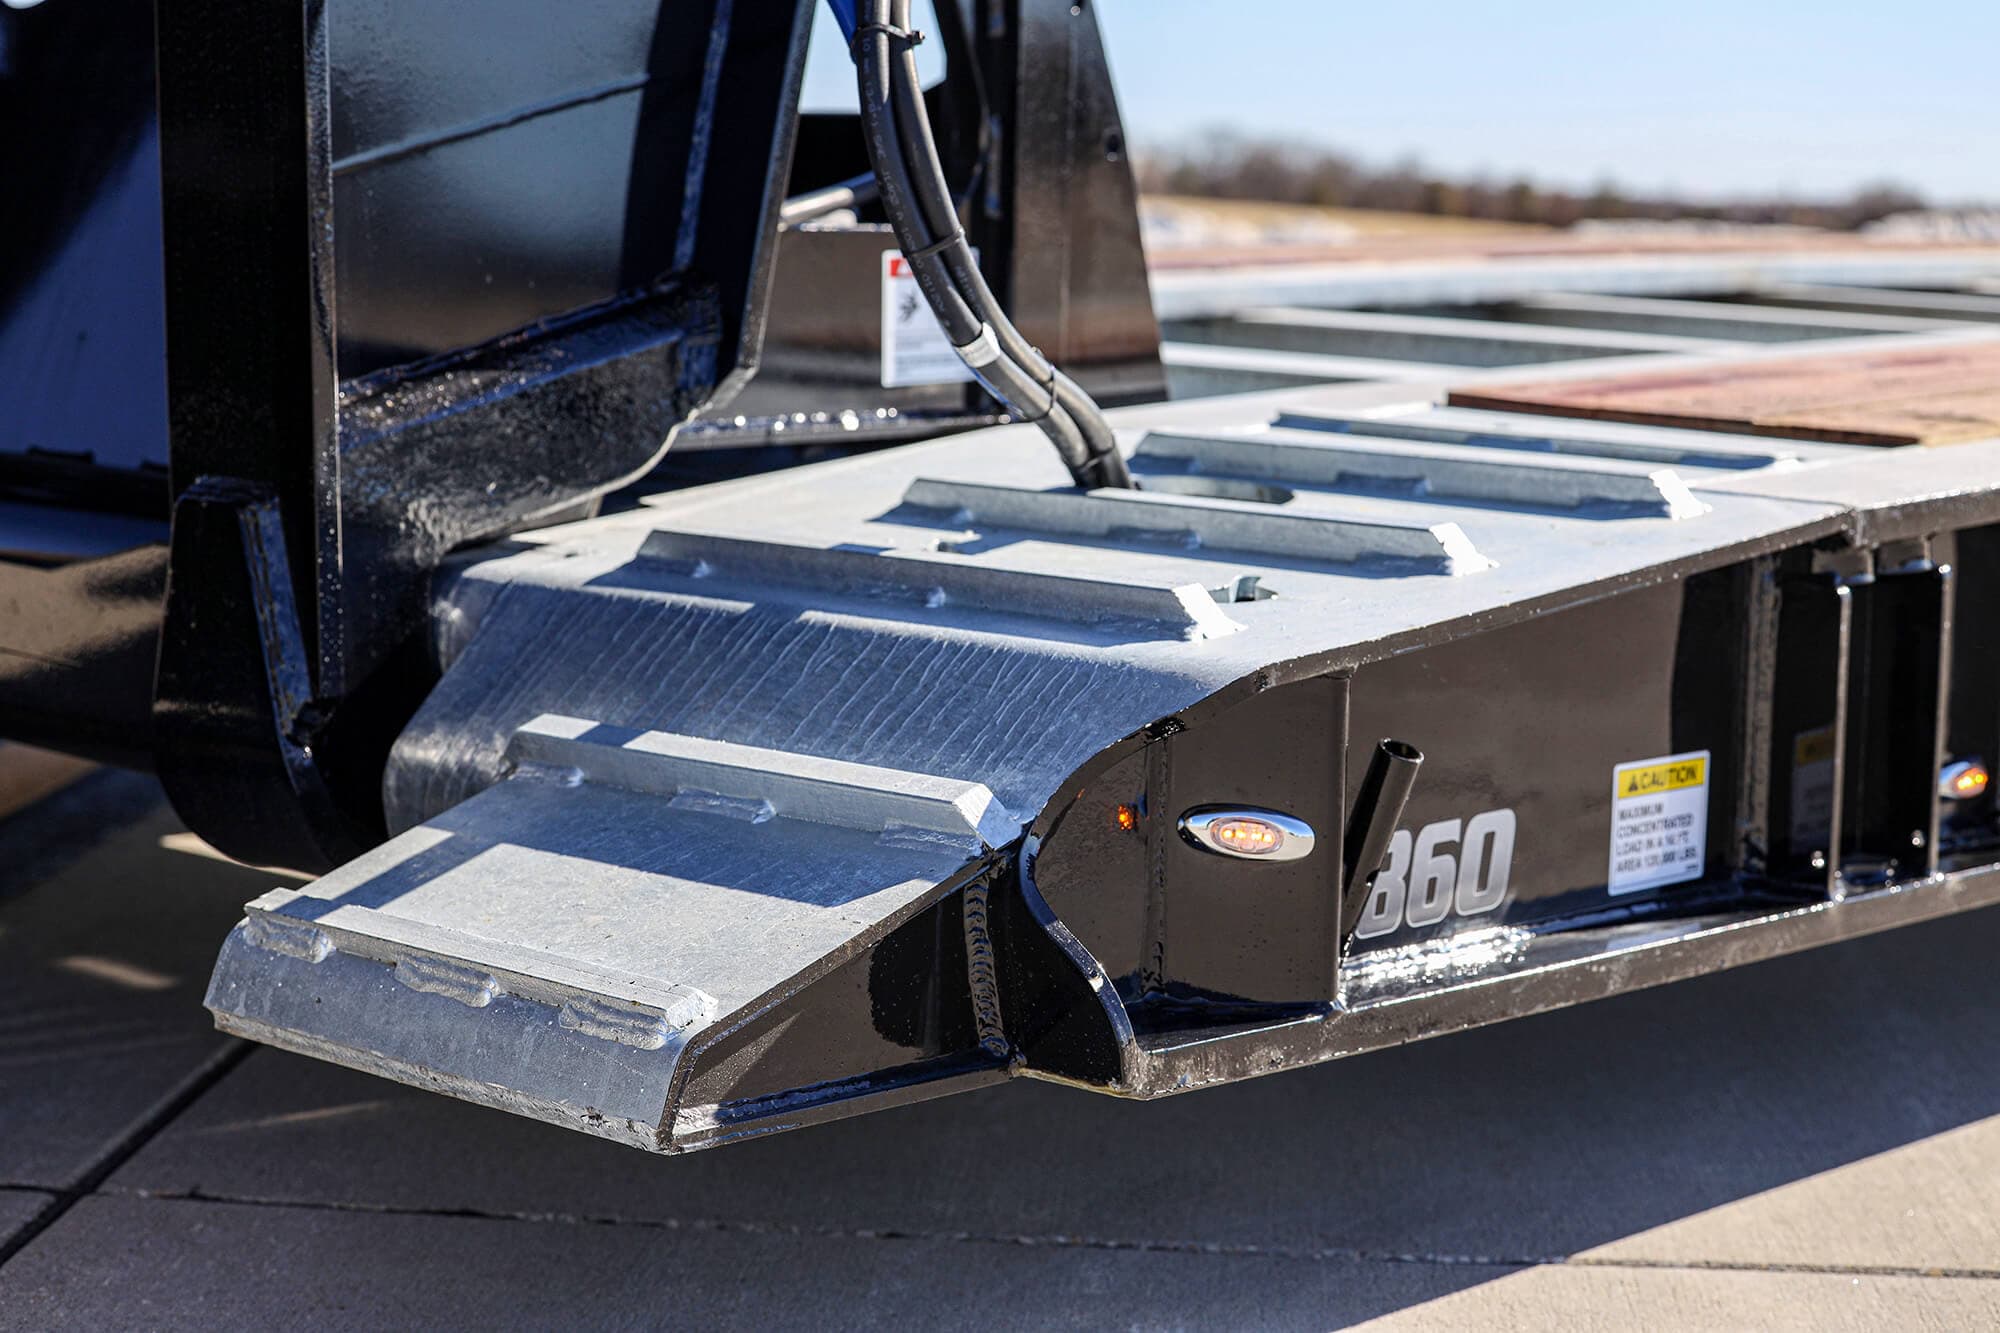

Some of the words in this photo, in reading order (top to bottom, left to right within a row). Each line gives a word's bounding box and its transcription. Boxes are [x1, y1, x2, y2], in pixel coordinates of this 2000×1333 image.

[1640, 763, 1698, 790] CAUTION
[1618, 802, 1664, 821] MAXIMUM
[1617, 812, 1694, 839] CONCENTRATED
[1616, 840, 1642, 856] LOAD
[1616, 856, 1642, 873] AREA
